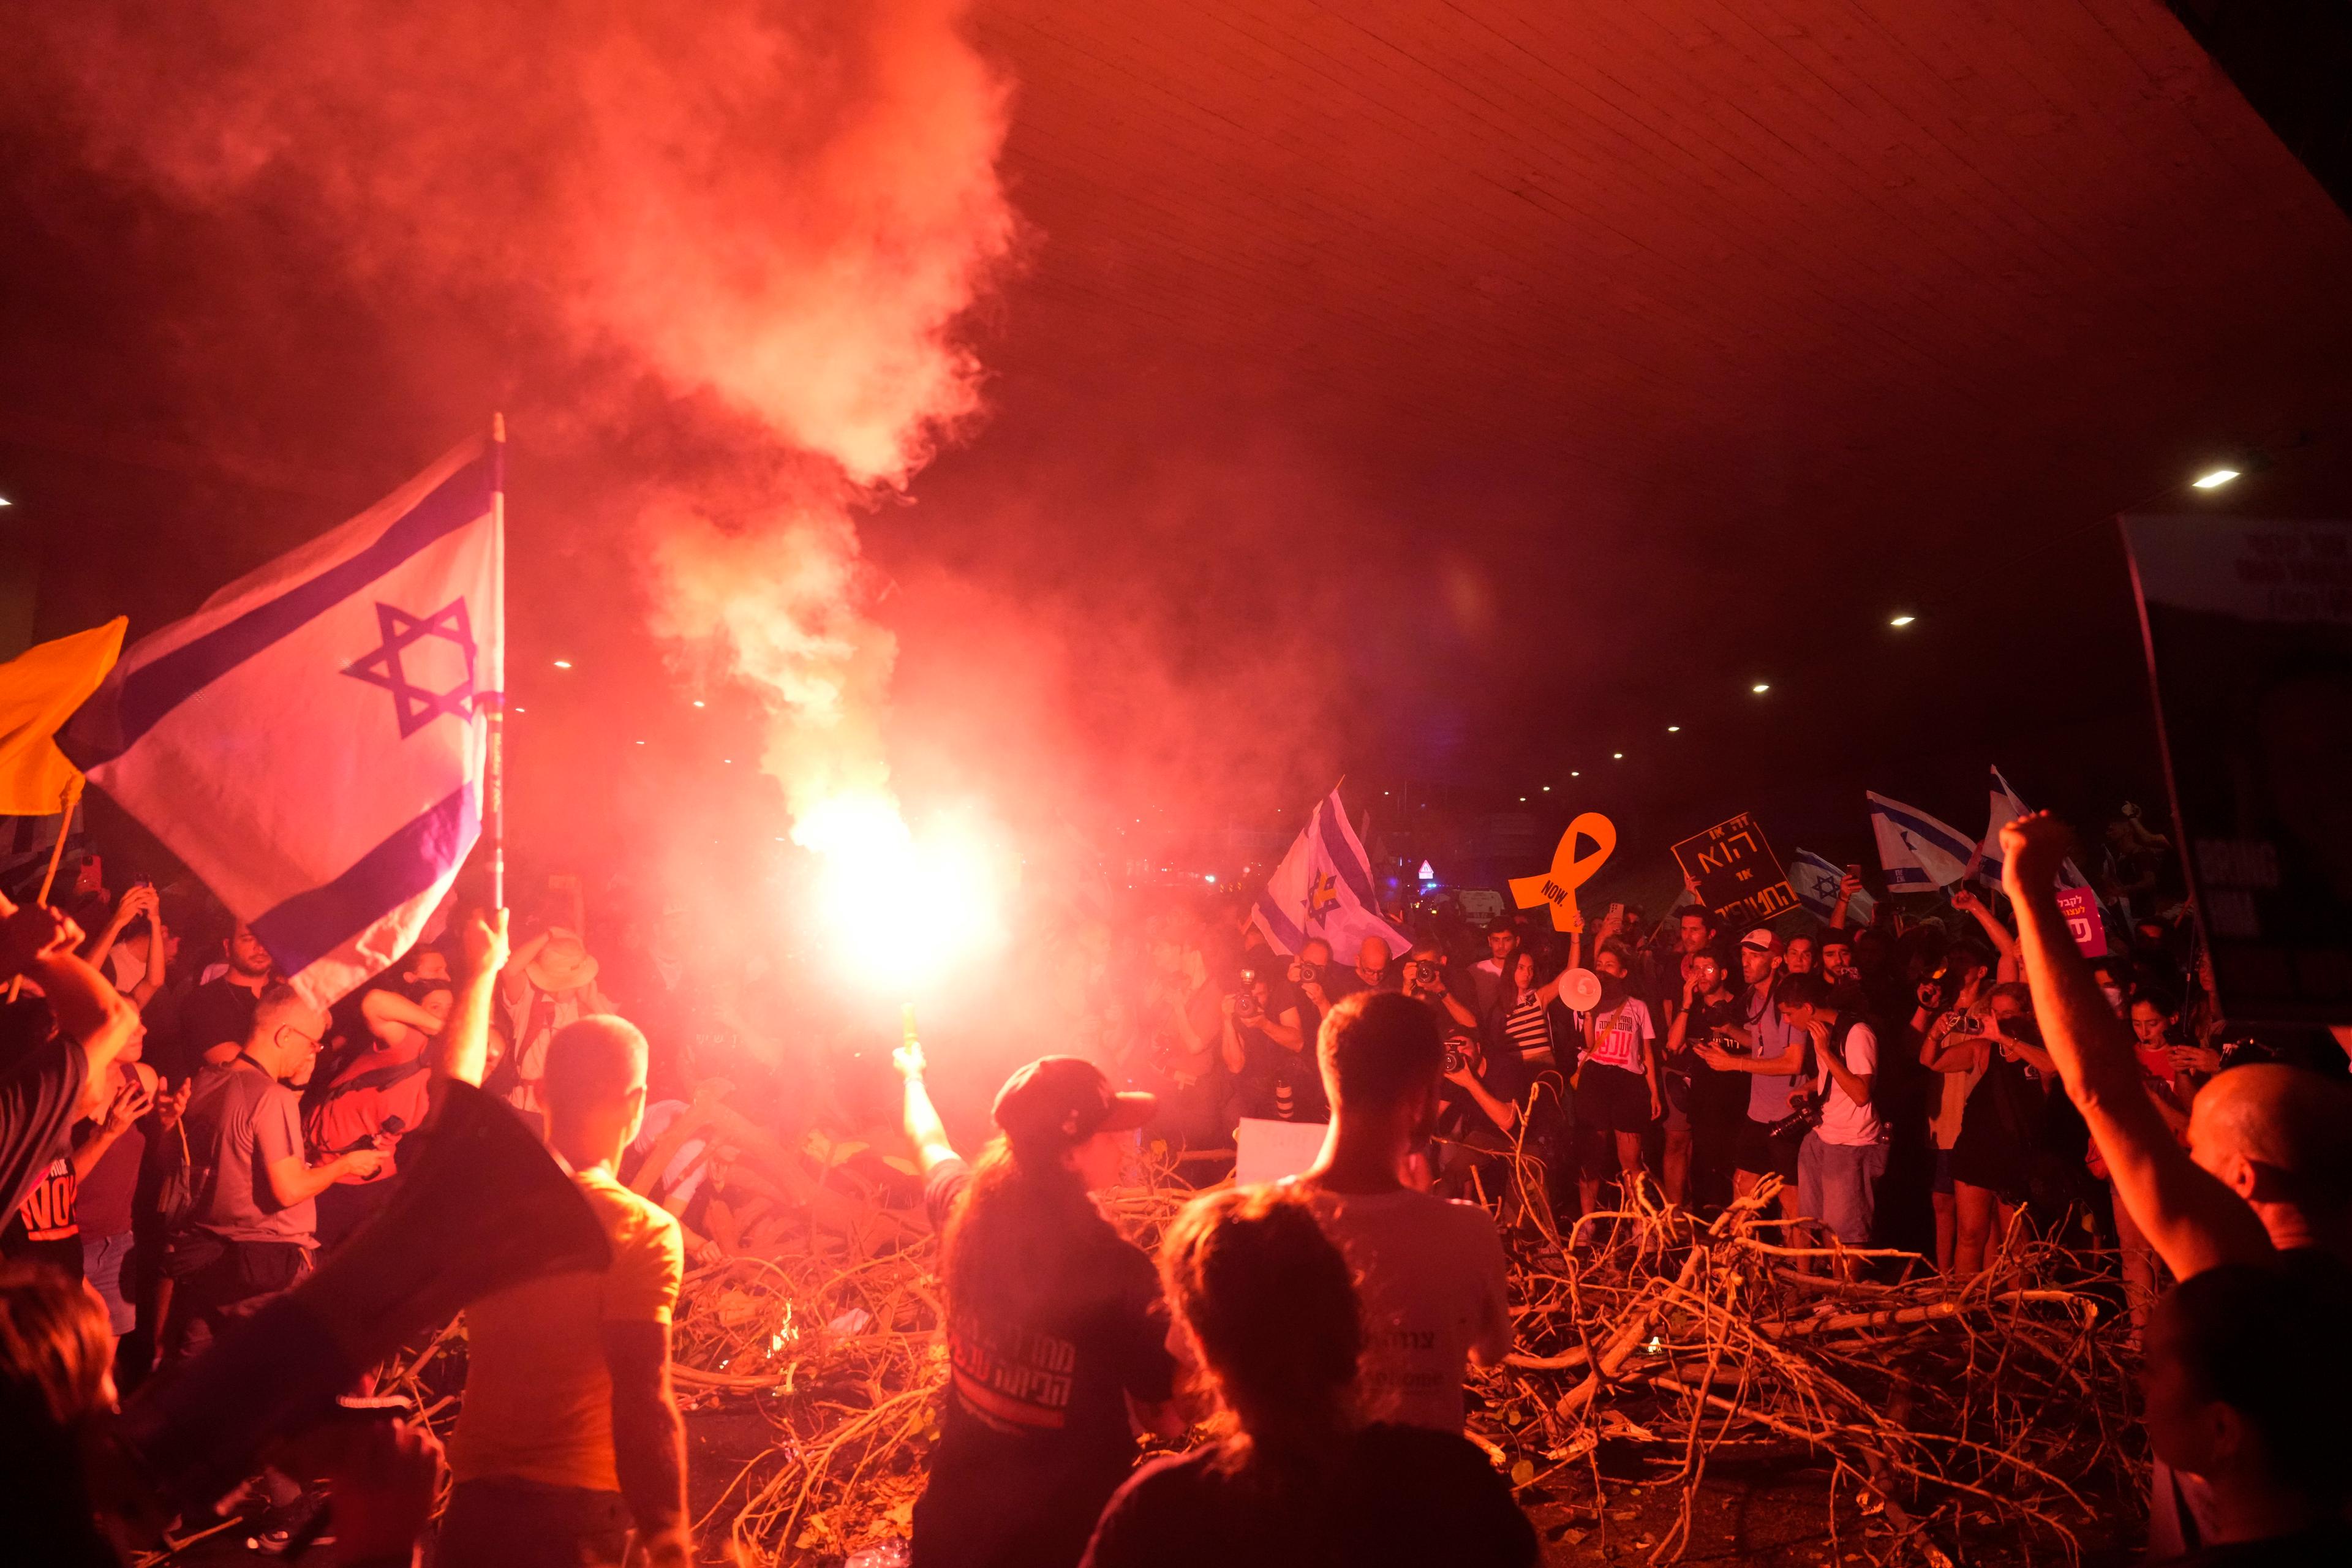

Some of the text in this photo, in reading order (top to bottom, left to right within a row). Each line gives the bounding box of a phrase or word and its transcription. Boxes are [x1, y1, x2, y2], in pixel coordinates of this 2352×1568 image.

[1708, 827, 1725, 840] או
[1697, 831, 1758, 875] הוא
[1735, 867, 1754, 882] או
[1541, 880, 1568, 907] NOW.
[2057, 895, 2082, 907] לקבל
